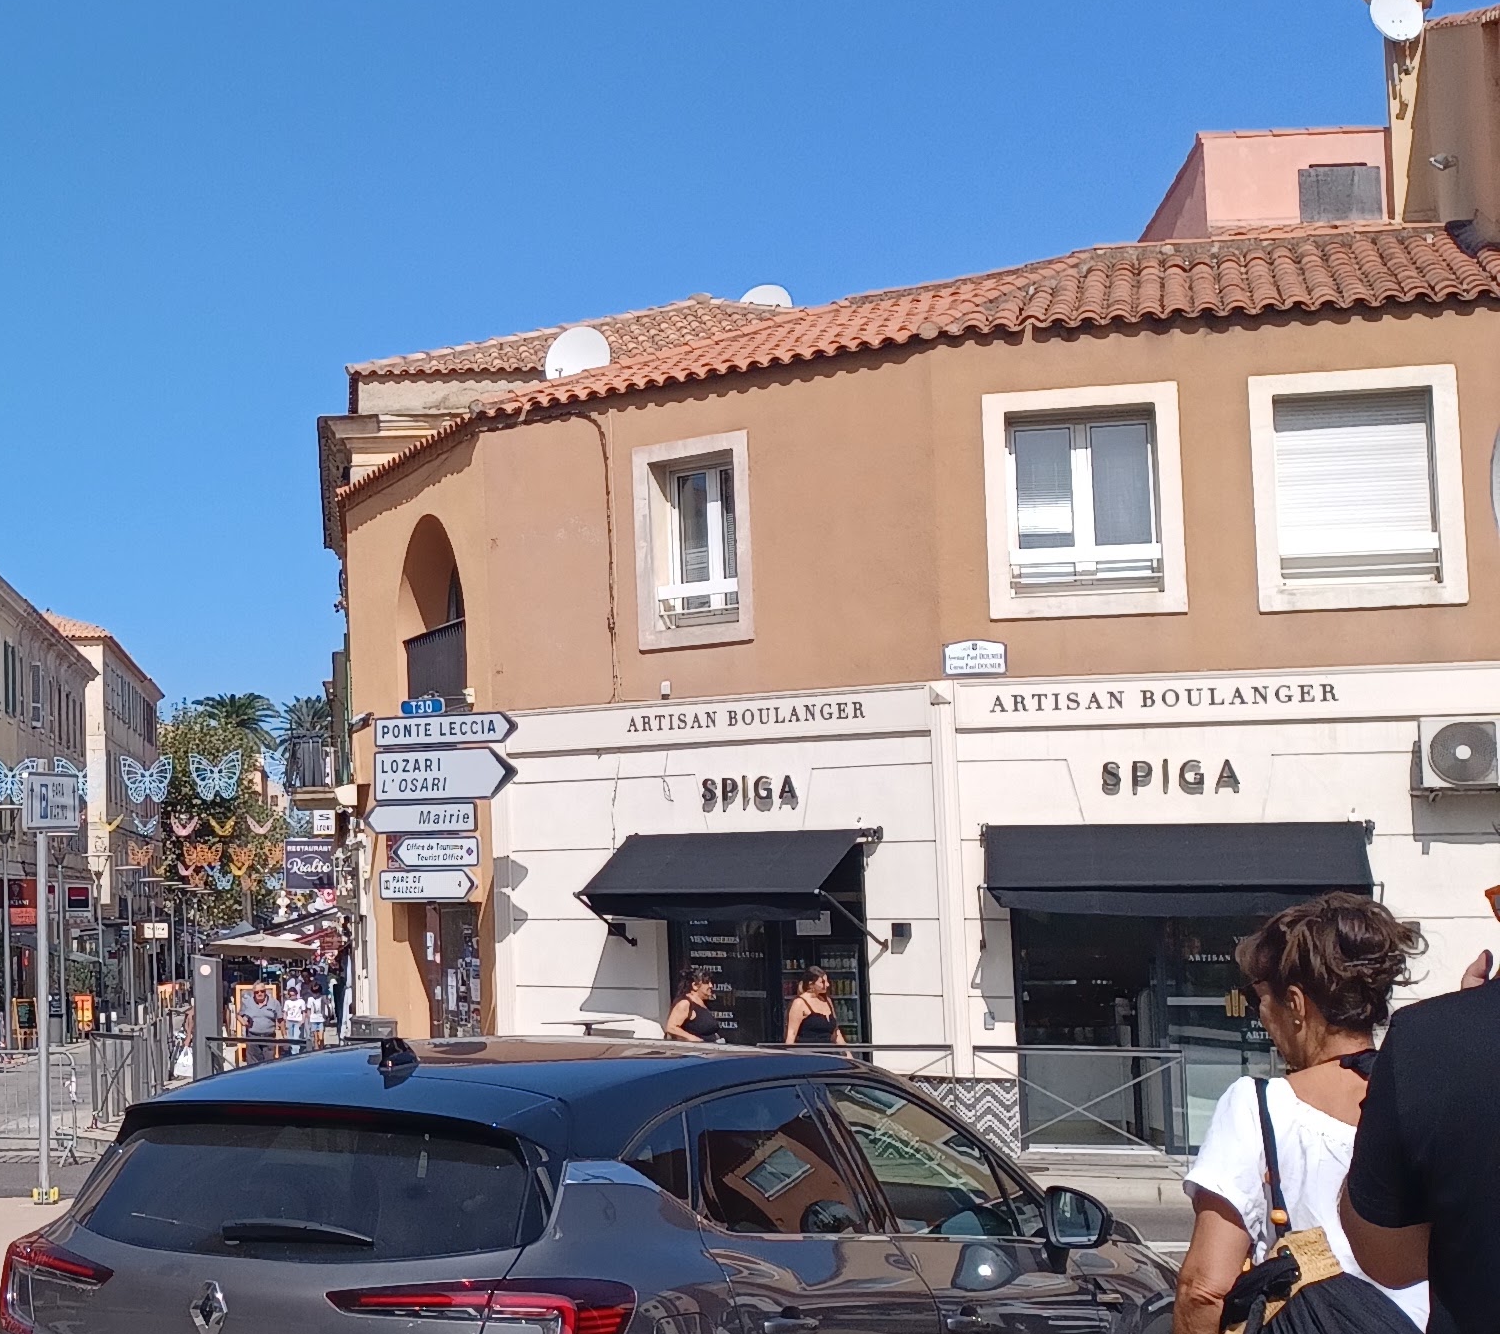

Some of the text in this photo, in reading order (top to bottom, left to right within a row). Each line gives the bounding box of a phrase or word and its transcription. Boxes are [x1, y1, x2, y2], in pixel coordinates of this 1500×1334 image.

[989, 683, 1340, 714] ARTISAN BOULANGER
[410, 701, 433, 714] T30
[626, 701, 867, 733] ARTISAN BOULANGER
[381, 720, 497, 740] PONTE LECCIA
[381, 758, 441, 774] LOZARI
[1101, 759, 1241, 791] SPIGA
[381, 777, 447, 794] L'OSARI
[701, 775, 797, 805] SPIGA
[418, 810, 470, 825] Mairie
[406, 843, 425, 851] Office
[417, 852, 464, 862] Tourist Office
[287, 857, 333, 876] Rialto
[392, 875, 422, 884] PARC DE
[1188, 953, 1232, 962] ARTISAN
